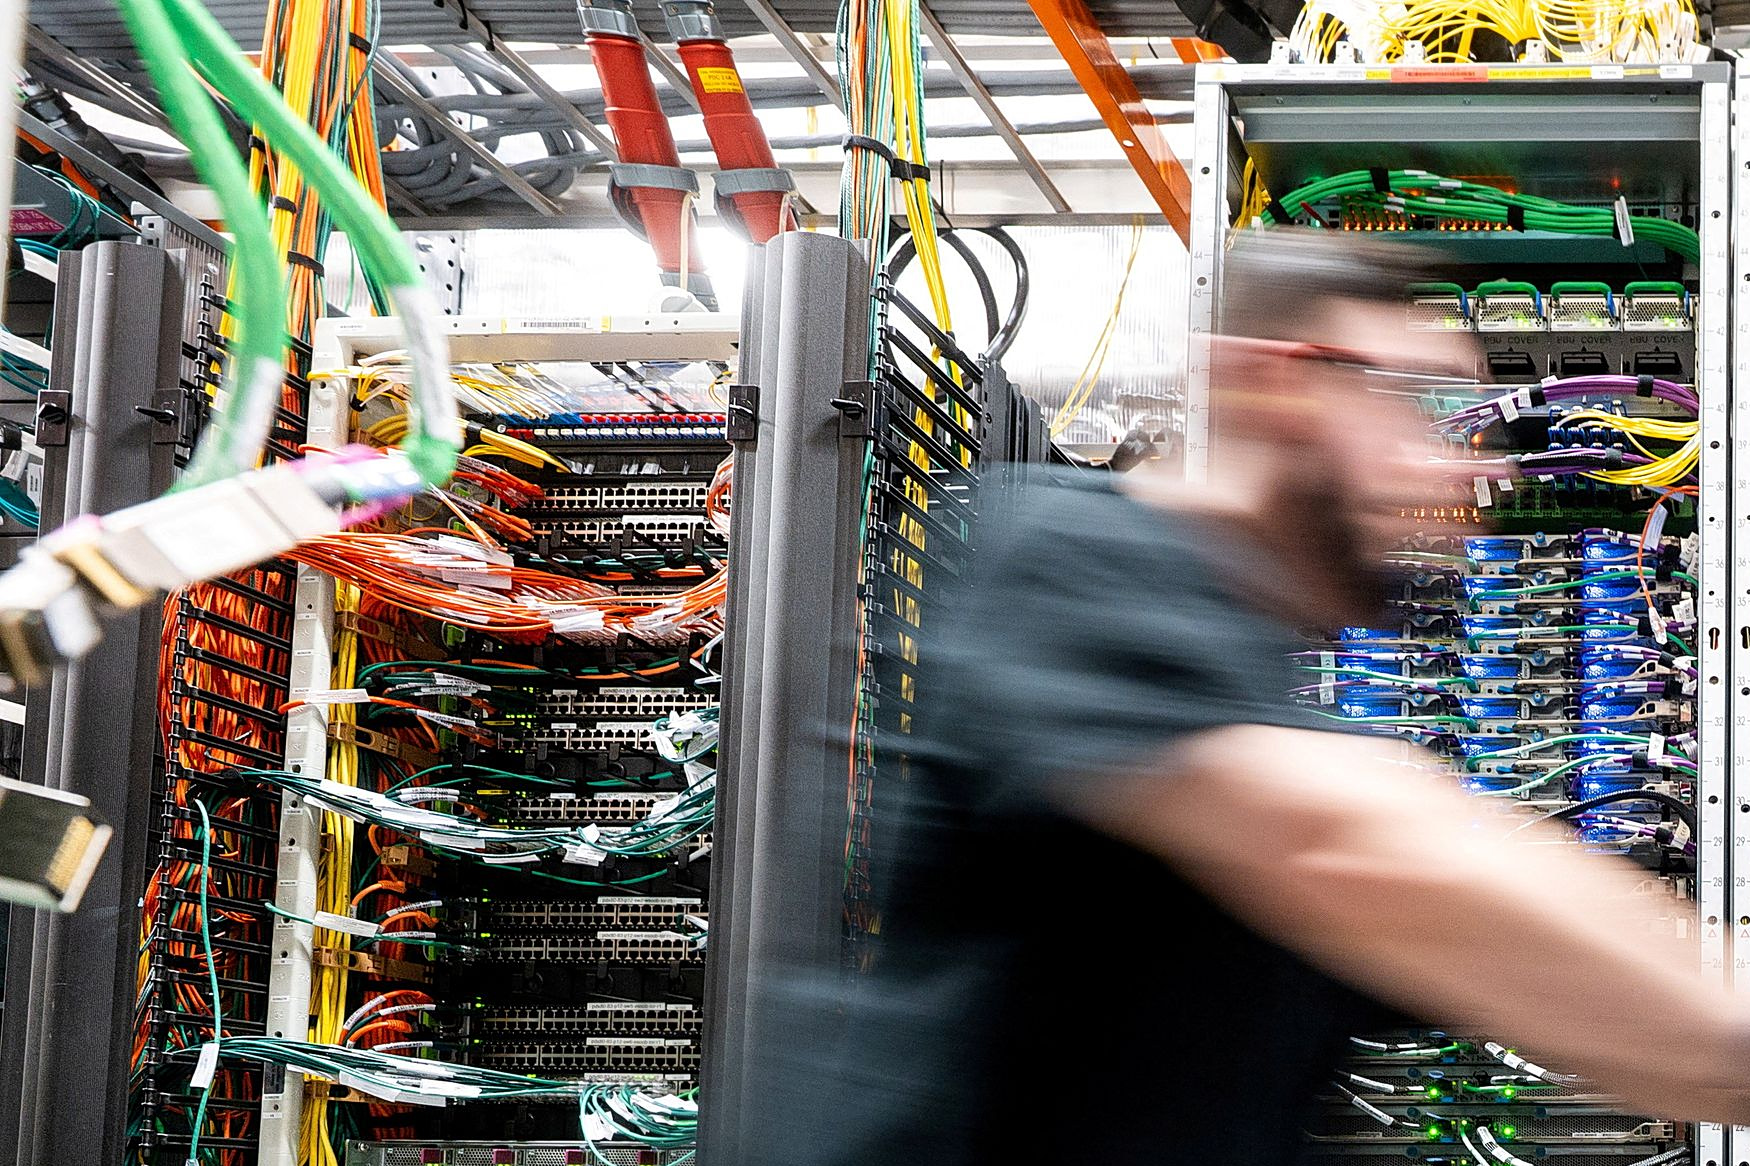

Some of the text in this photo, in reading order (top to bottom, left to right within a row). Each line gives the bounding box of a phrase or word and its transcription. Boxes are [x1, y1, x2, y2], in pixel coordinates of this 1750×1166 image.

[1192, 288, 1202, 298] 43
[1716, 481, 1724, 491] 38
[1715, 558, 1724, 568] 36
[1737, 596, 1746, 607] 35
[1737, 676, 1746, 686] 33
[1714, 756, 1723, 766] 31
[1713, 836, 1722, 847] 29
[1736, 836, 1746, 847] 29
[1712, 876, 1723, 887] 28
[1736, 876, 1746, 887] 28
